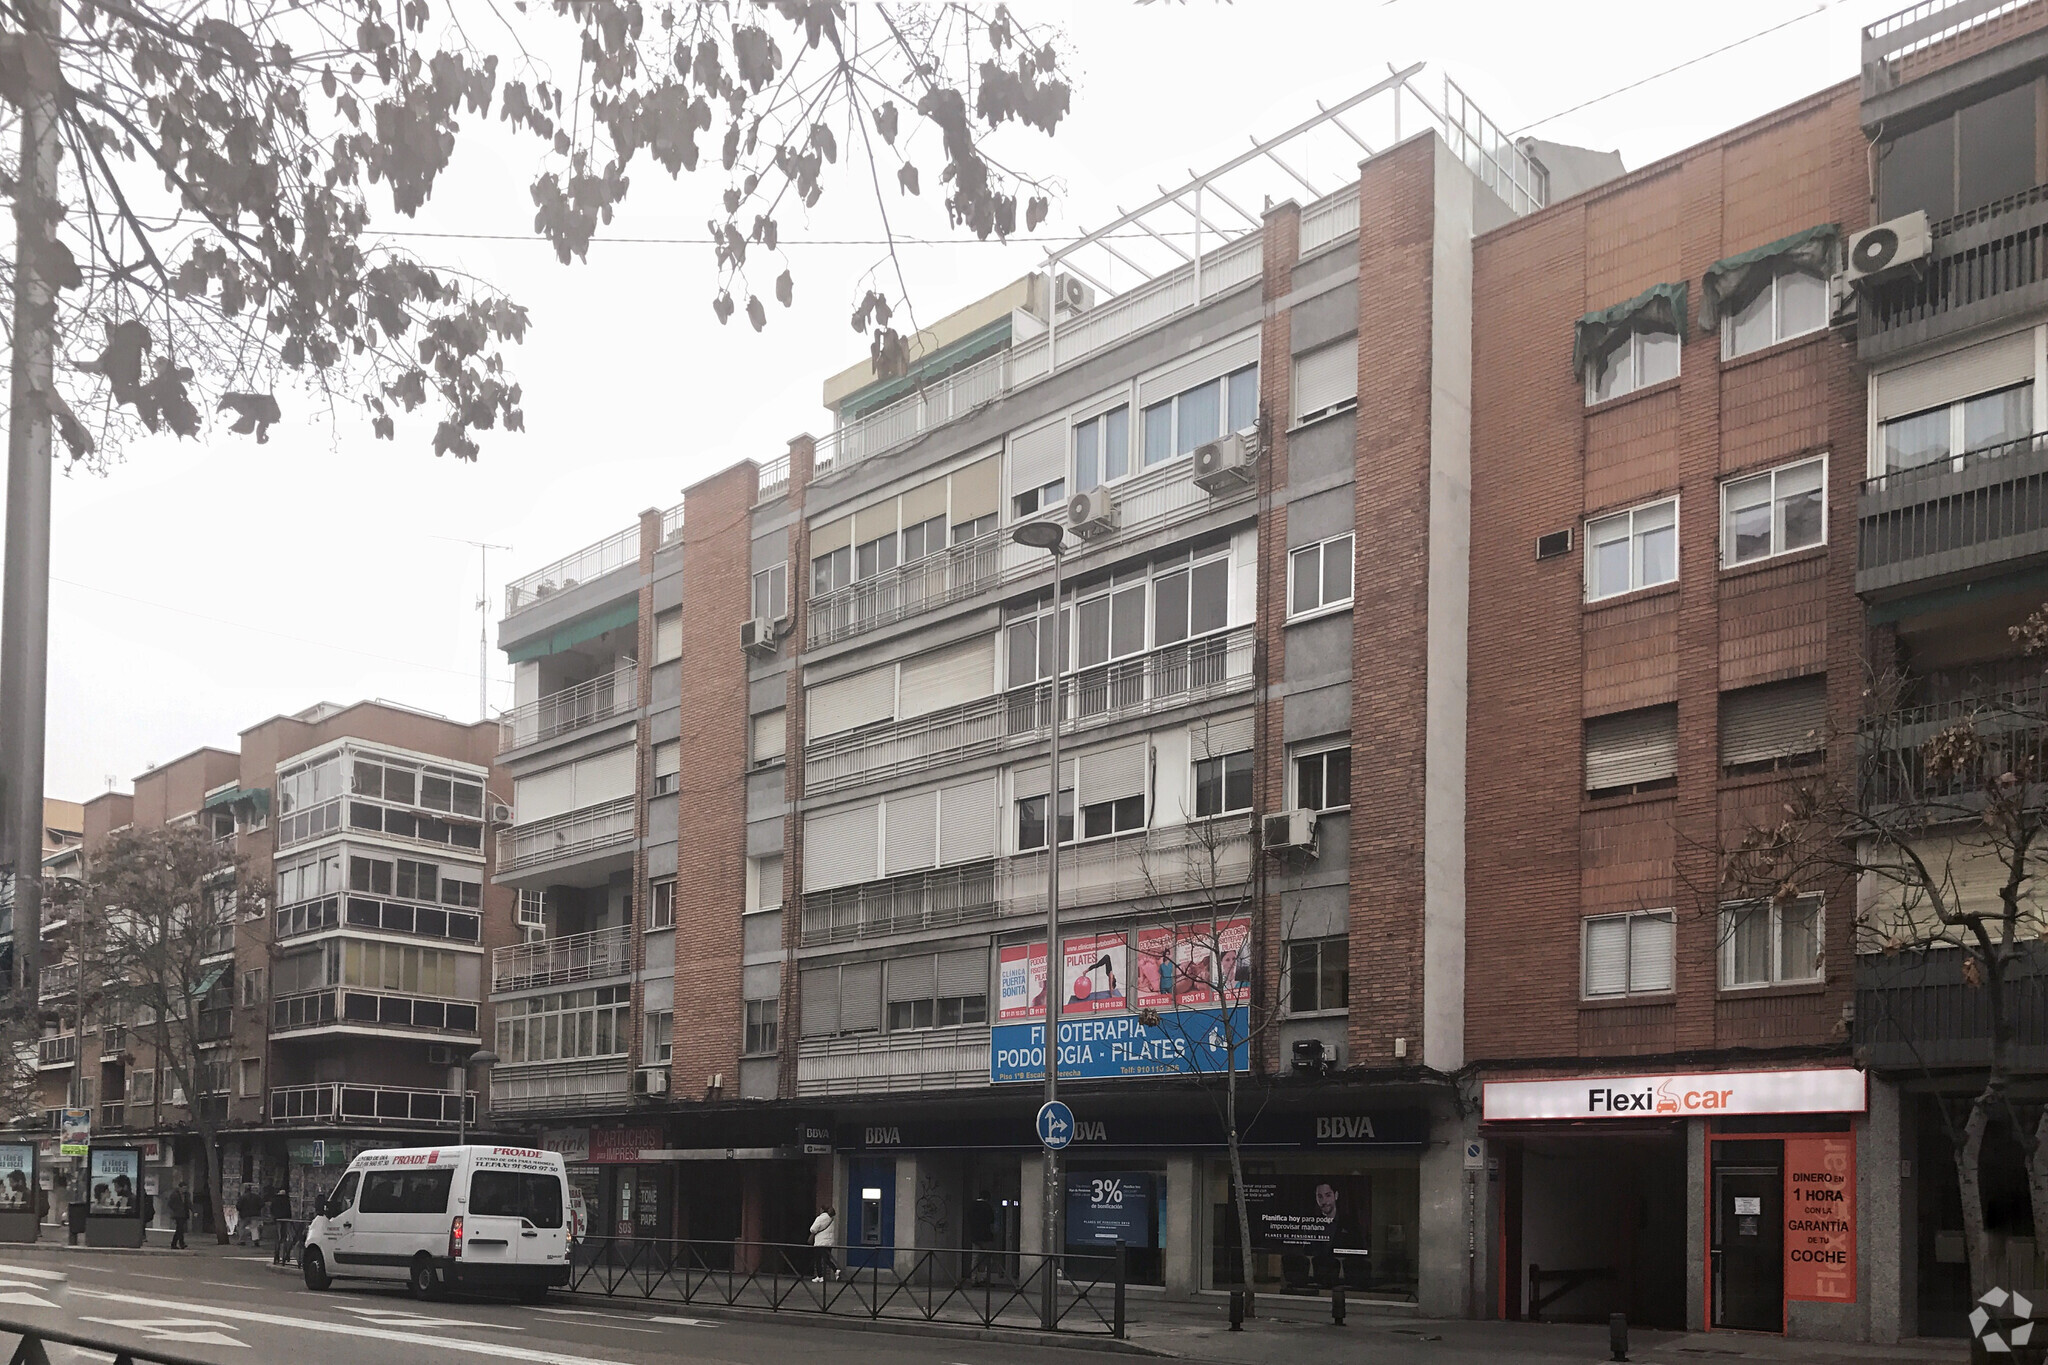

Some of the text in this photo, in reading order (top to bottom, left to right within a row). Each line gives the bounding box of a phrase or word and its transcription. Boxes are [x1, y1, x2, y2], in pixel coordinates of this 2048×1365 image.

[1067, 952, 1097, 967] PILATES
[1002, 976, 1026, 987] PUERTA
[1002, 985, 1026, 998] BONITA
[1182, 994, 1195, 1004] PISO
[998, 1038, 1186, 1068] PODOOGIA PILATES
[1026, 1071, 1046, 1079] Escale
[1136, 1065, 1150, 1074] 910
[1589, 1087, 1733, 1112] Flexi car
[807, 1128, 830, 1138] BBVA
[1074, 1121, 1107, 1141] BVA
[1316, 1116, 1375, 1138] BBVA
[597, 1128, 656, 1148] CARTUCHOS
[866, 1127, 901, 1144] BBVA
[493, 1147, 543, 1159] PROADE
[392, 1154, 428, 1165] PROADE
[1792, 1173, 1845, 1183] DINERO EN
[1091, 1178, 1123, 1204] 3%
[1793, 1188, 1844, 1202] 1 HORA
[640, 1215, 657, 1226] PAPE
[1261, 1214, 1288, 1222] Planifica
[1288, 1215, 1300, 1223] hoy
[1316, 1216, 1334, 1224] poder
[1788, 1218, 1849, 1232] GARANTÍA
[618, 1222, 632, 1234] SOS
[1270, 1223, 1325, 1231] improvisar mañana
[1807, 1236, 1819, 1244] DE
[1790, 1249, 1847, 1264] COCHE
